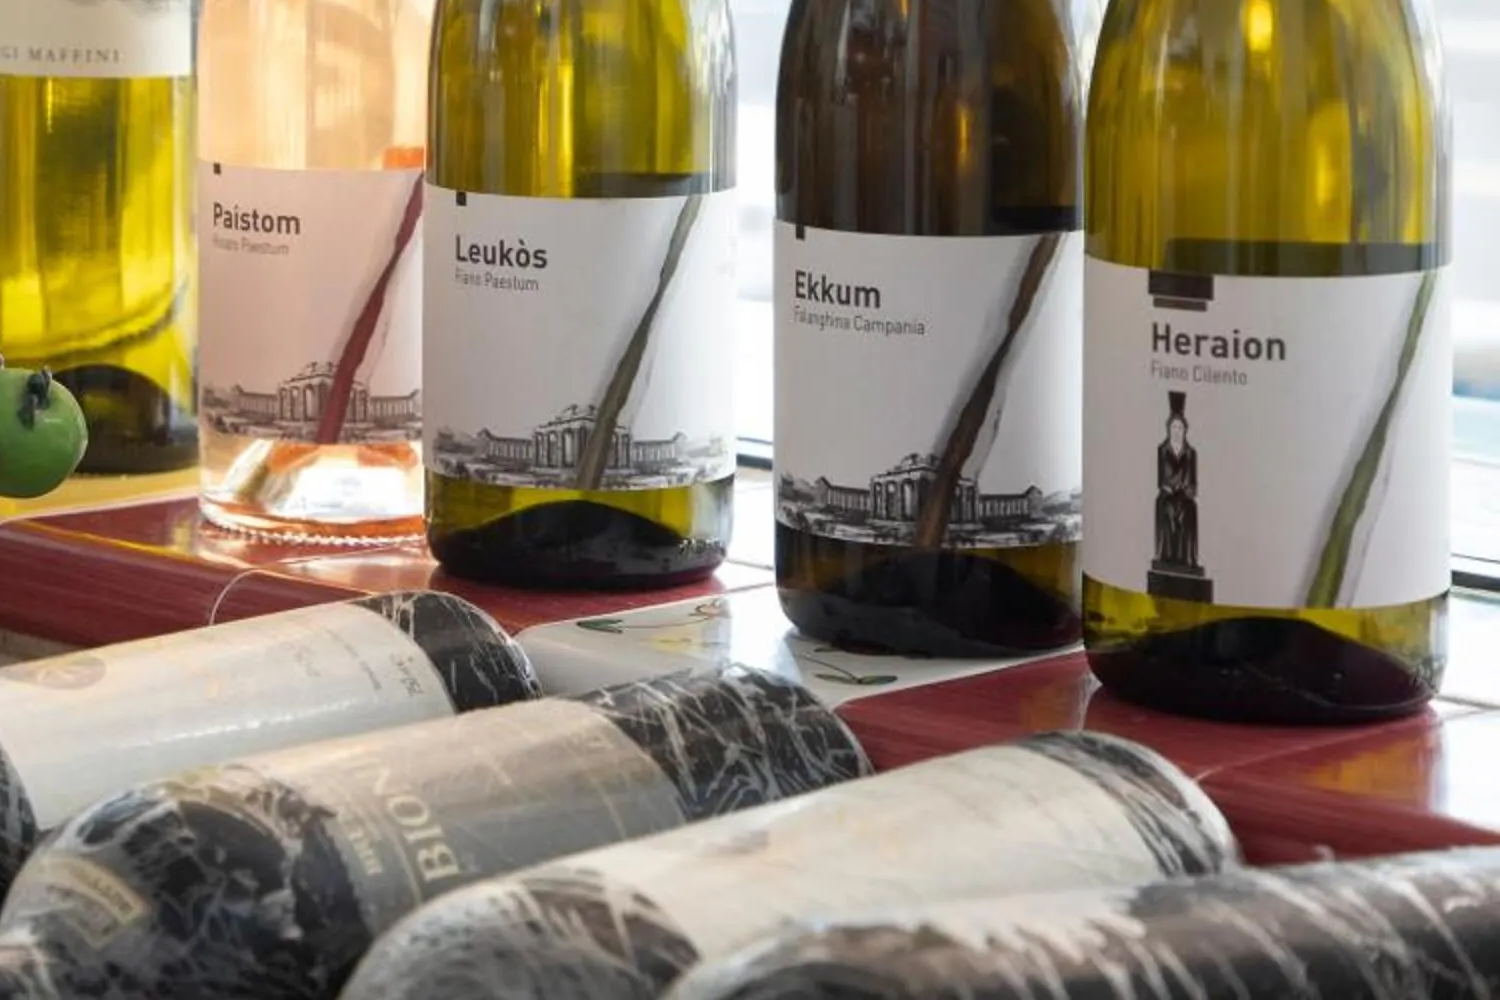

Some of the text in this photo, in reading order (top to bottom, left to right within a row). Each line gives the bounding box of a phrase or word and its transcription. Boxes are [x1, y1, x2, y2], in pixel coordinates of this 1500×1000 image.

[28, 46, 120, 64] MAFFINI
[213, 202, 300, 235] Paistom
[455, 233, 548, 269] Leukòs
[794, 269, 881, 309] Ekkum
[853, 314, 925, 336] Campania
[1151, 320, 1287, 361] Heraion
[1192, 364, 1248, 386] Cilento
